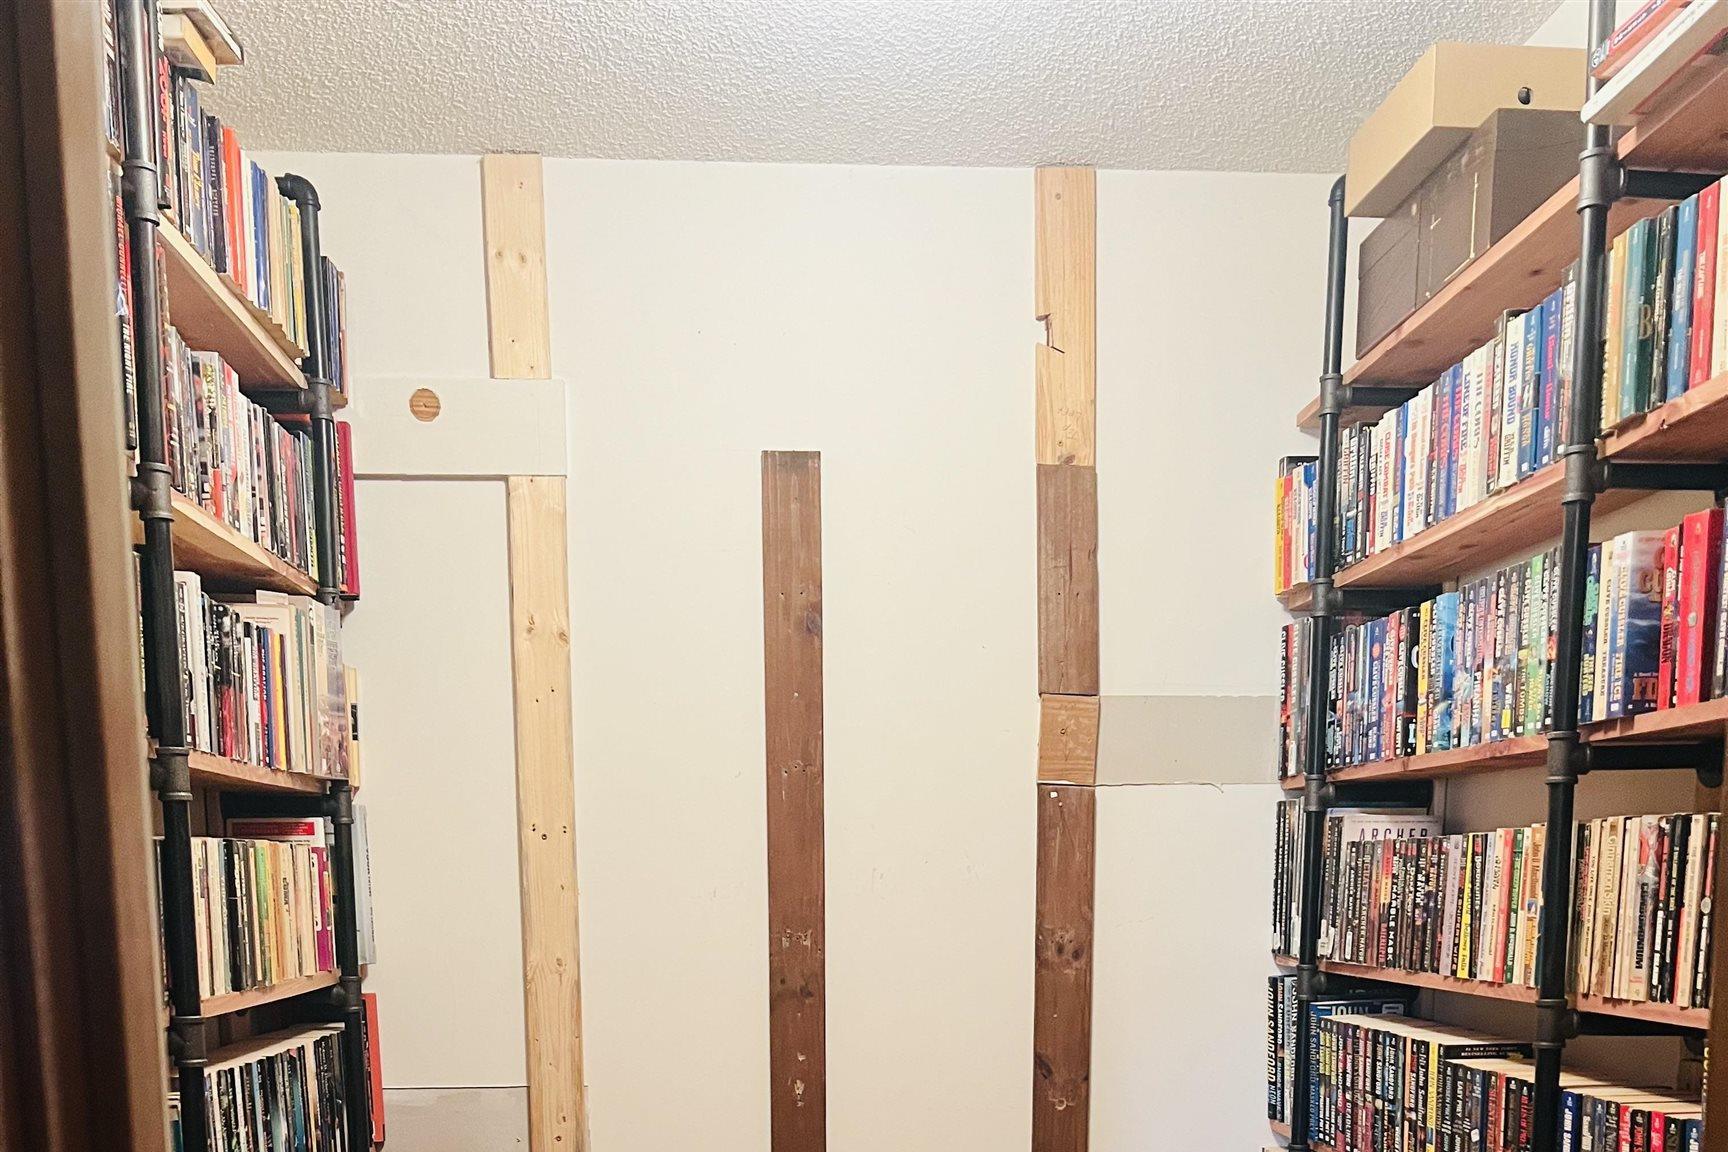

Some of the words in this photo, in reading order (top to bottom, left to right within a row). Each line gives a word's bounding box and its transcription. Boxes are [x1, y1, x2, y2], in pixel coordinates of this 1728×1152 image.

[116, 195, 124, 238] MICHAEL
[122, 323, 130, 341] THE
[123, 343, 131, 372] NIGHT
[1508, 343, 1518, 384] HONOR
[125, 374, 133, 395] FIRE
[1506, 387, 1516, 425] BOUND
[1618, 566, 1627, 594] CLIVE
[1616, 596, 1625, 647] CUSSLER
[1718, 612, 1726, 637] CLIVE
[1397, 642, 1405, 664] CLIVE
[1661, 623, 1673, 664] DRAGON
[1615, 653, 1623, 678] FIRE
[1396, 665, 1404, 701] CUSSLER
[1613, 681, 1622, 701] ICE
[1472, 672, 1482, 726] PIRANHA
[1518, 686, 1526, 722] TOMBS
[1358, 827, 1430, 841] ARCHER
[1604, 836, 1617, 891] Cinnamon
[1388, 884, 1397, 927] MARBLE
[1603, 892, 1615, 915] Skin
[1309, 1011, 1317, 1036] JOHN
[1309, 1037, 1317, 1083] SANDFORD
[1268, 1085, 1276, 1104] NEON
[1388, 1065, 1396, 1100] SANDFORD
[1417, 1089, 1425, 1127] Sandford
[1455, 1100, 1463, 1118] PREY
[1487, 1089, 1495, 1121] SILENT
[1564, 1108, 1572, 1131] JOHN
[1486, 1123, 1495, 1148] PREY
[1519, 1129, 1527, 1147] PREY
[1635, 1125, 1644, 1146] JOHN
